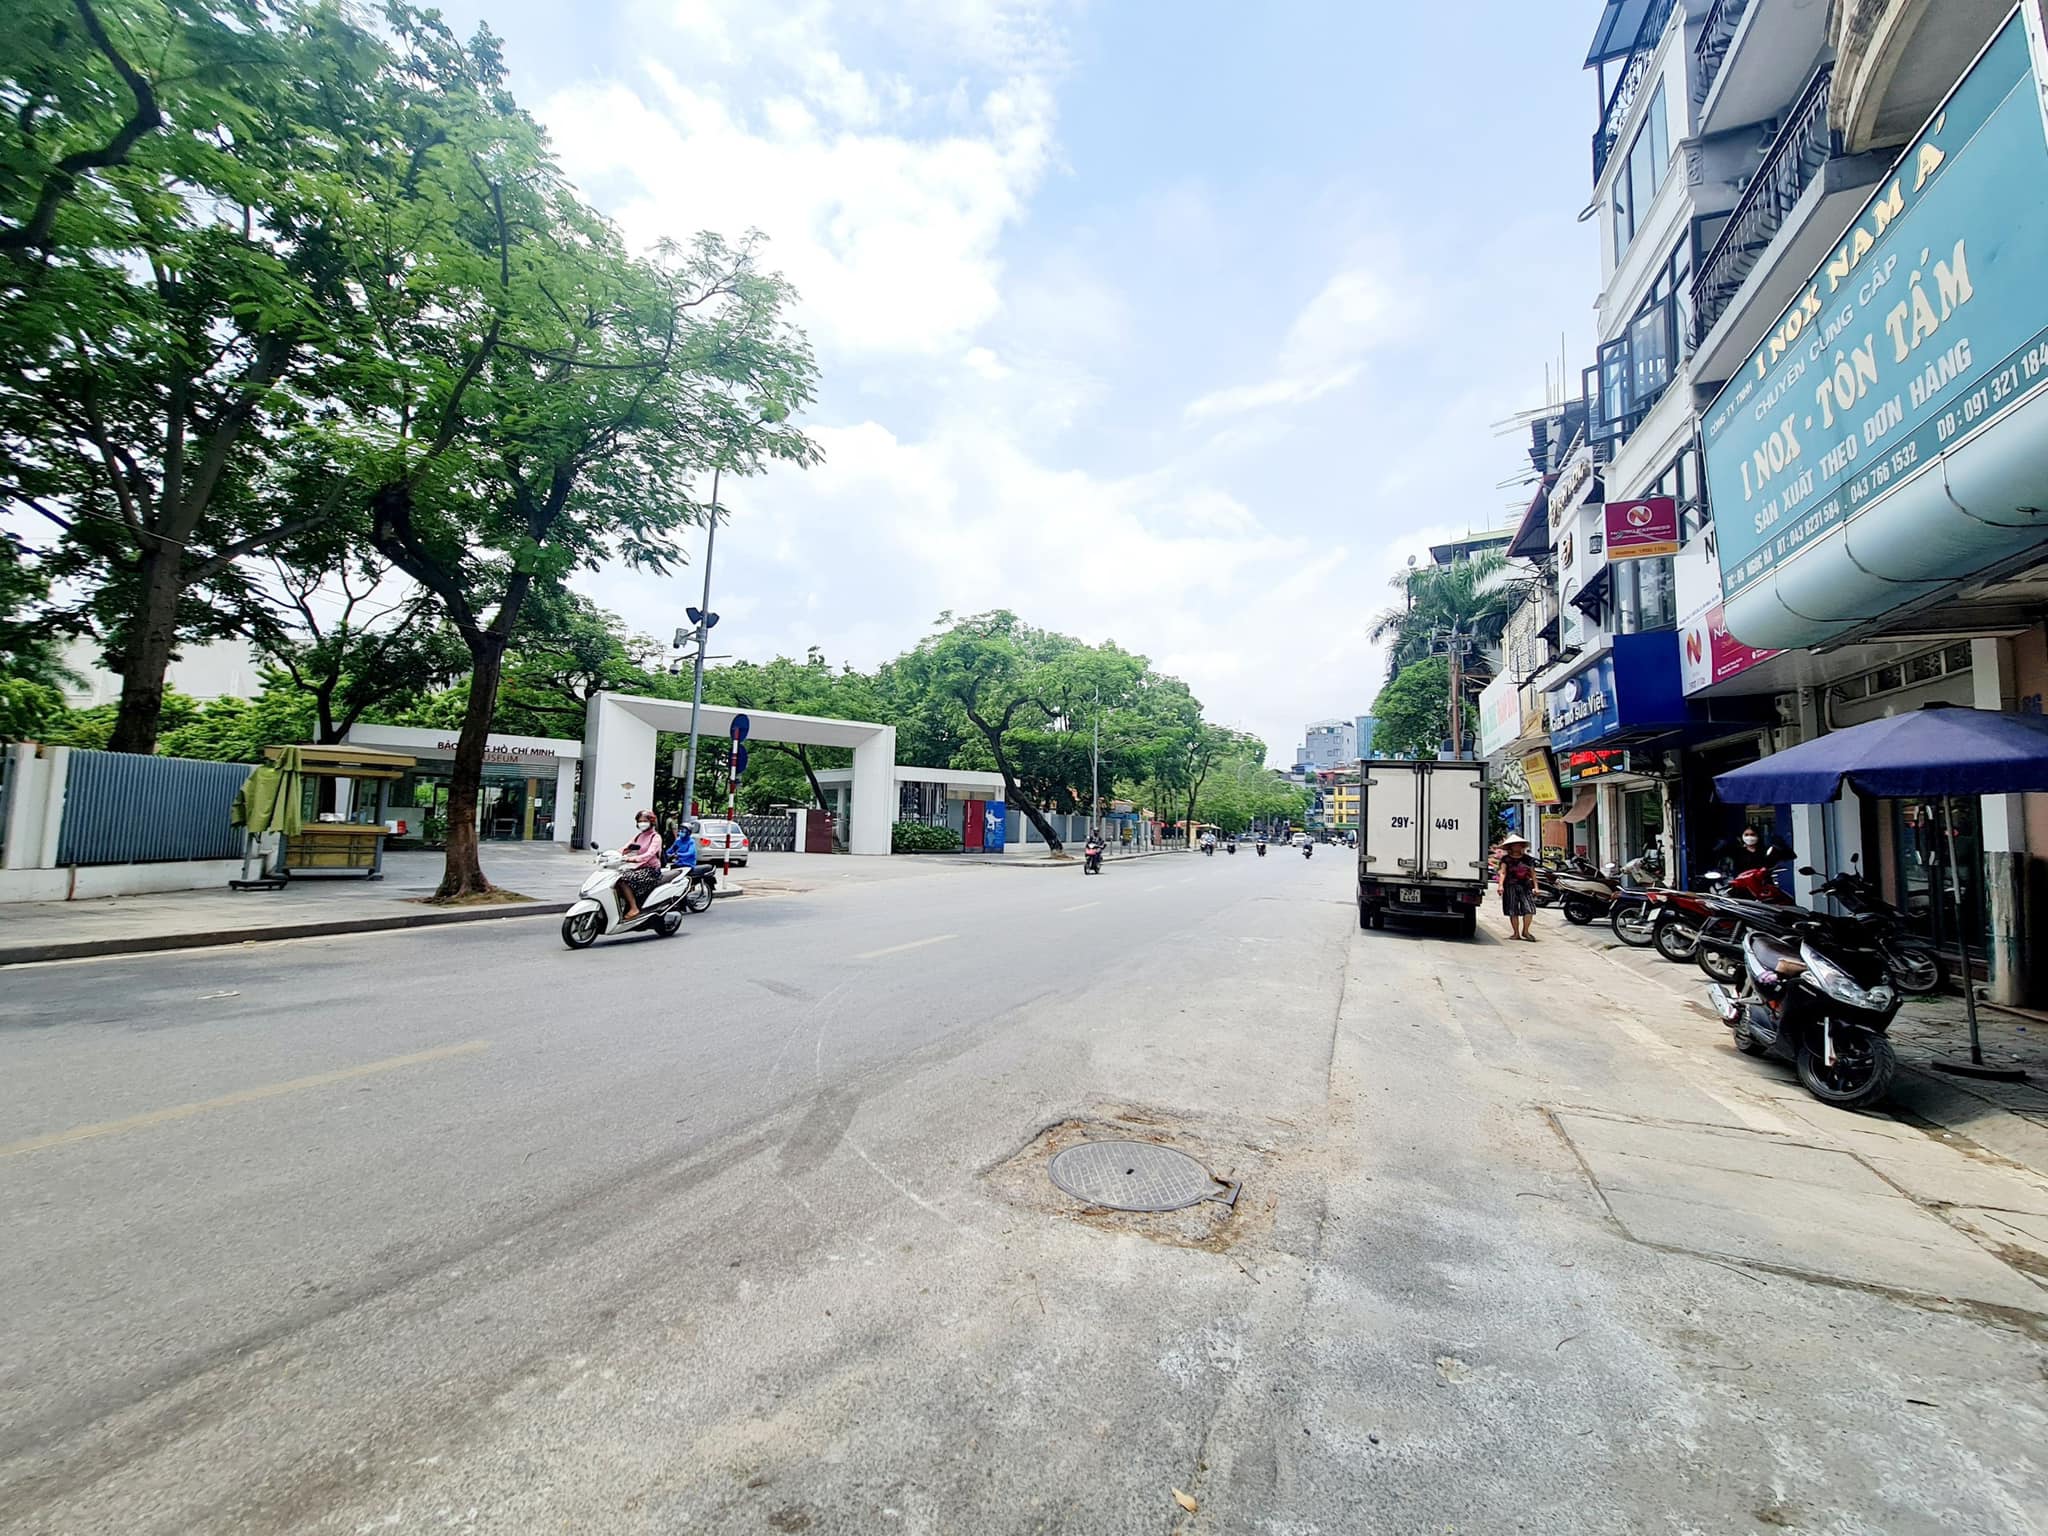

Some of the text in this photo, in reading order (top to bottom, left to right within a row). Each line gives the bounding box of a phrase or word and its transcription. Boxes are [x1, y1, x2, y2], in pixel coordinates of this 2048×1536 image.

[1826, 178, 1905, 294] NAM
[1755, 254, 1897, 421] CHUYÊN CUNG CẤP
[1816, 333, 1878, 429] TÔN
[1886, 239, 1974, 364] TẤM
[1755, 338, 1973, 534] SẢN XUẤT THEO ĐƠN HÀNG
[1851, 477, 1869, 504] 043
[1871, 462, 1891, 489] 766
[1892, 441, 1919, 474] 1532
[1964, 386, 1989, 422] 091
[1991, 364, 2019, 402] 321
[437, 740, 459, 751] BẢO
[512, 745, 528, 755] CHÍ
[530, 748, 555, 757] MINH
[1435, 818, 1459, 831] 4491
